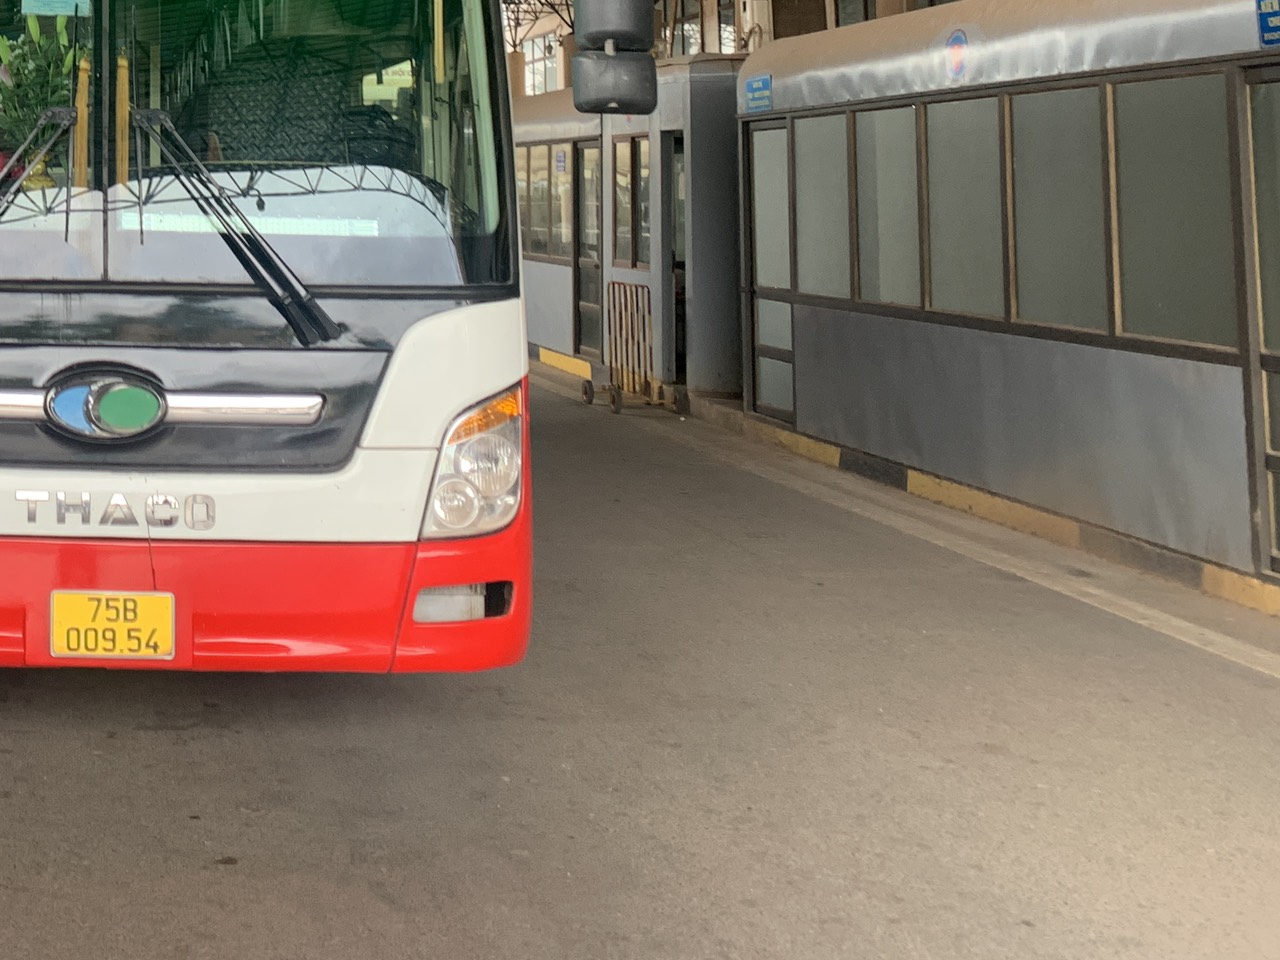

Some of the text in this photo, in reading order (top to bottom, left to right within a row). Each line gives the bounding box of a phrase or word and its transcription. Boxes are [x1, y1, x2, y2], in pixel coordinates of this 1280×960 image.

[15, 489, 217, 531] THACO
[87, 596, 138, 623] 75B
[66, 626, 160, 654] 009.54
